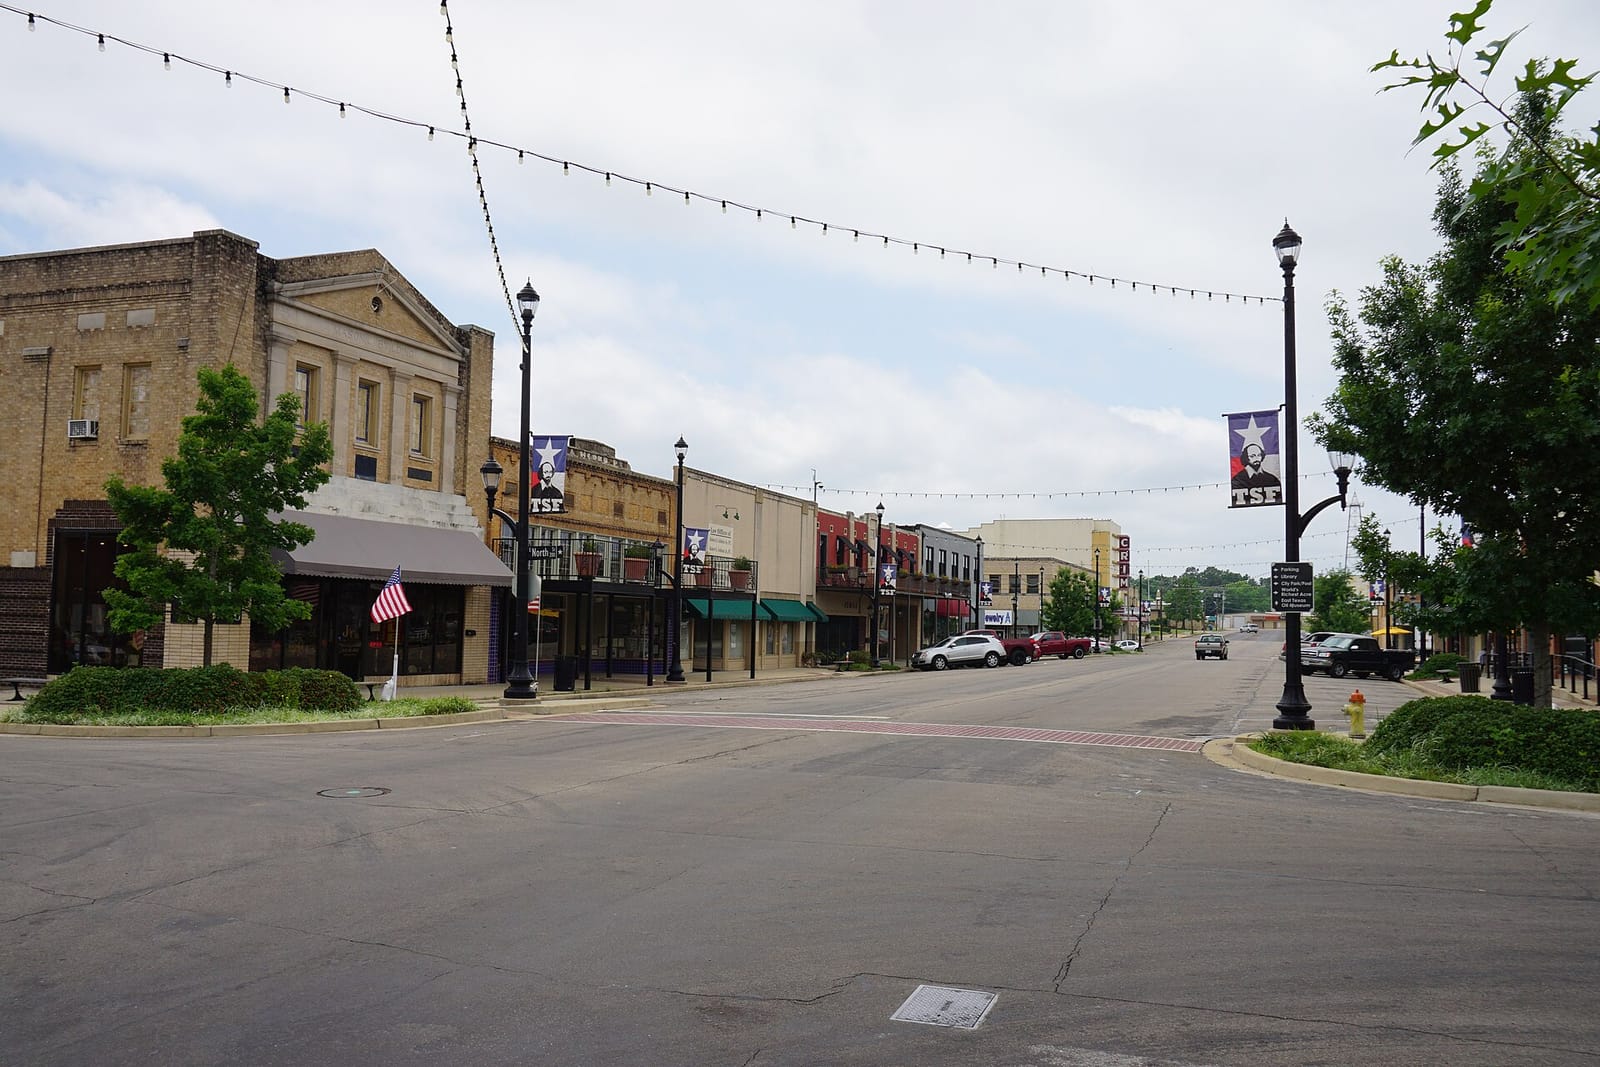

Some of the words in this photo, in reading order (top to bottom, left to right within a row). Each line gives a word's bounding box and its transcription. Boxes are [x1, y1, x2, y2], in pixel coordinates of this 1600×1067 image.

[1232, 486, 1281, 505] TSF
[531, 498, 563, 512] TSF
[531, 547, 549, 557] North
[683, 564, 703, 574] TSF
[1120, 538, 1129, 587] CRIM
[984, 612, 1004, 624] ewelry
